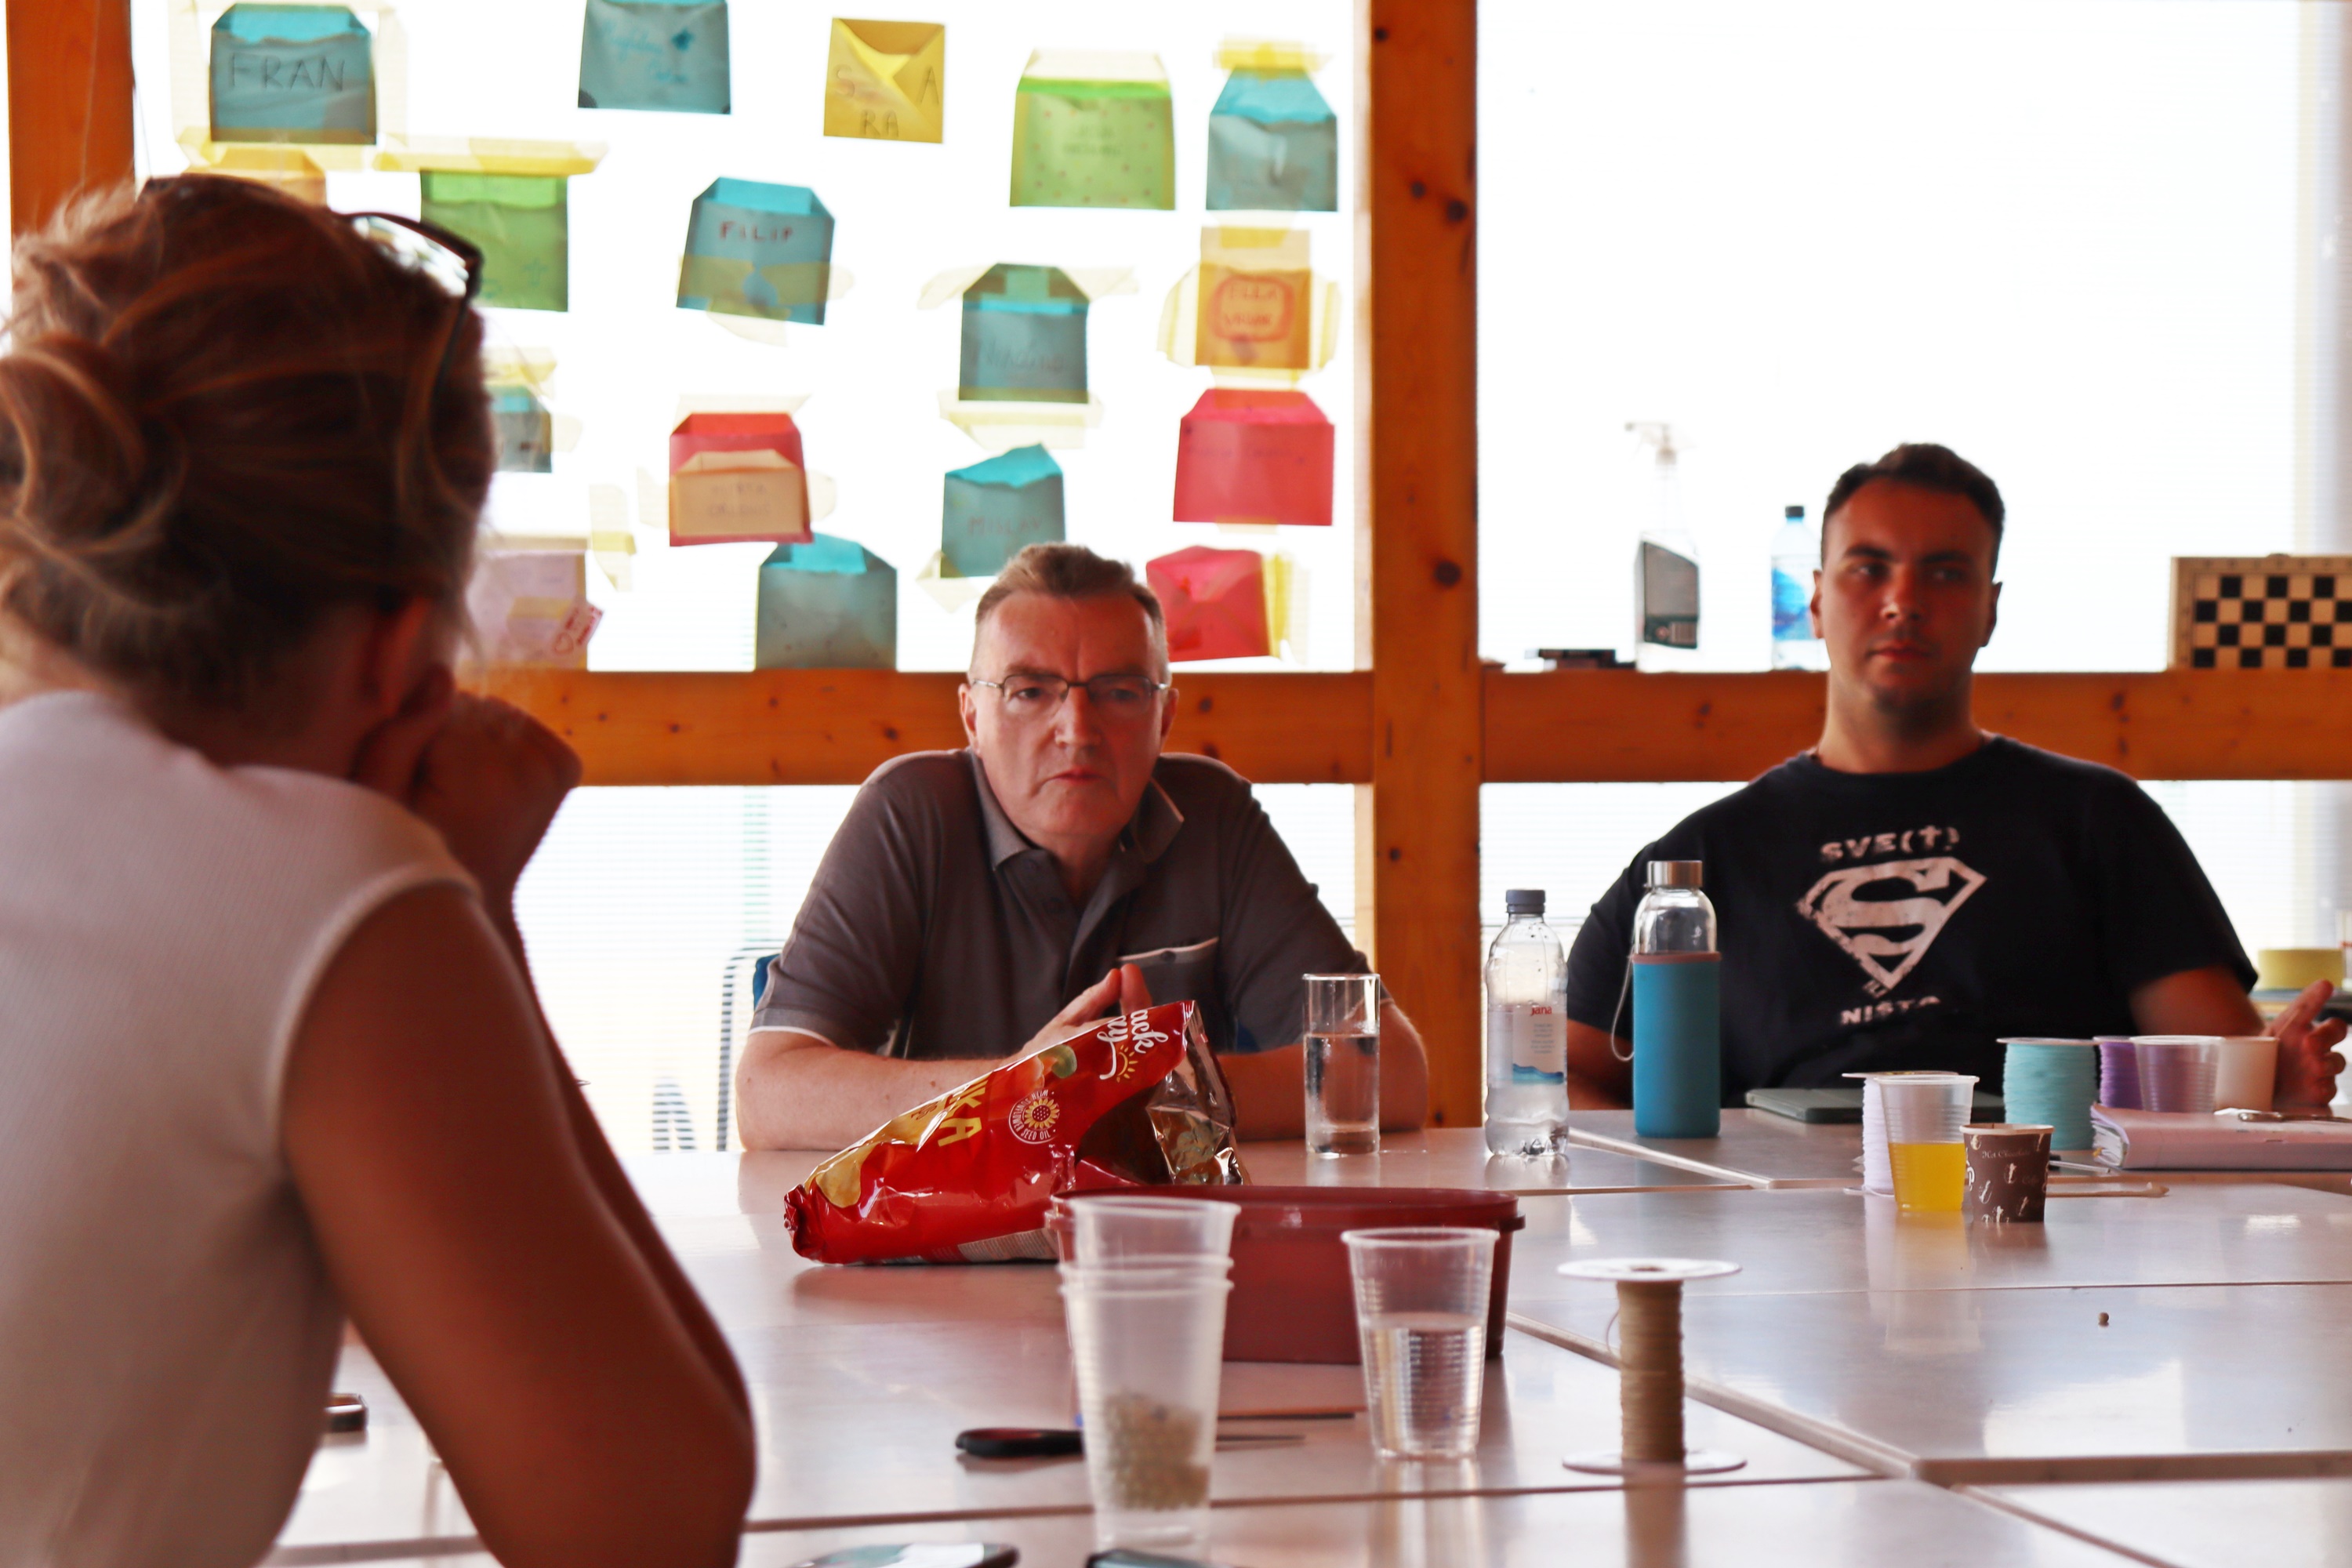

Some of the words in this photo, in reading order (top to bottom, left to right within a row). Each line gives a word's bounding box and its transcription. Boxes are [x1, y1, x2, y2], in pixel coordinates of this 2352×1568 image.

[230, 52, 346, 93] FRAN
[719, 221, 794, 242] FILIP
[1021, 1129, 1037, 1141] SEED
[1040, 1129, 1051, 1140] OIL
